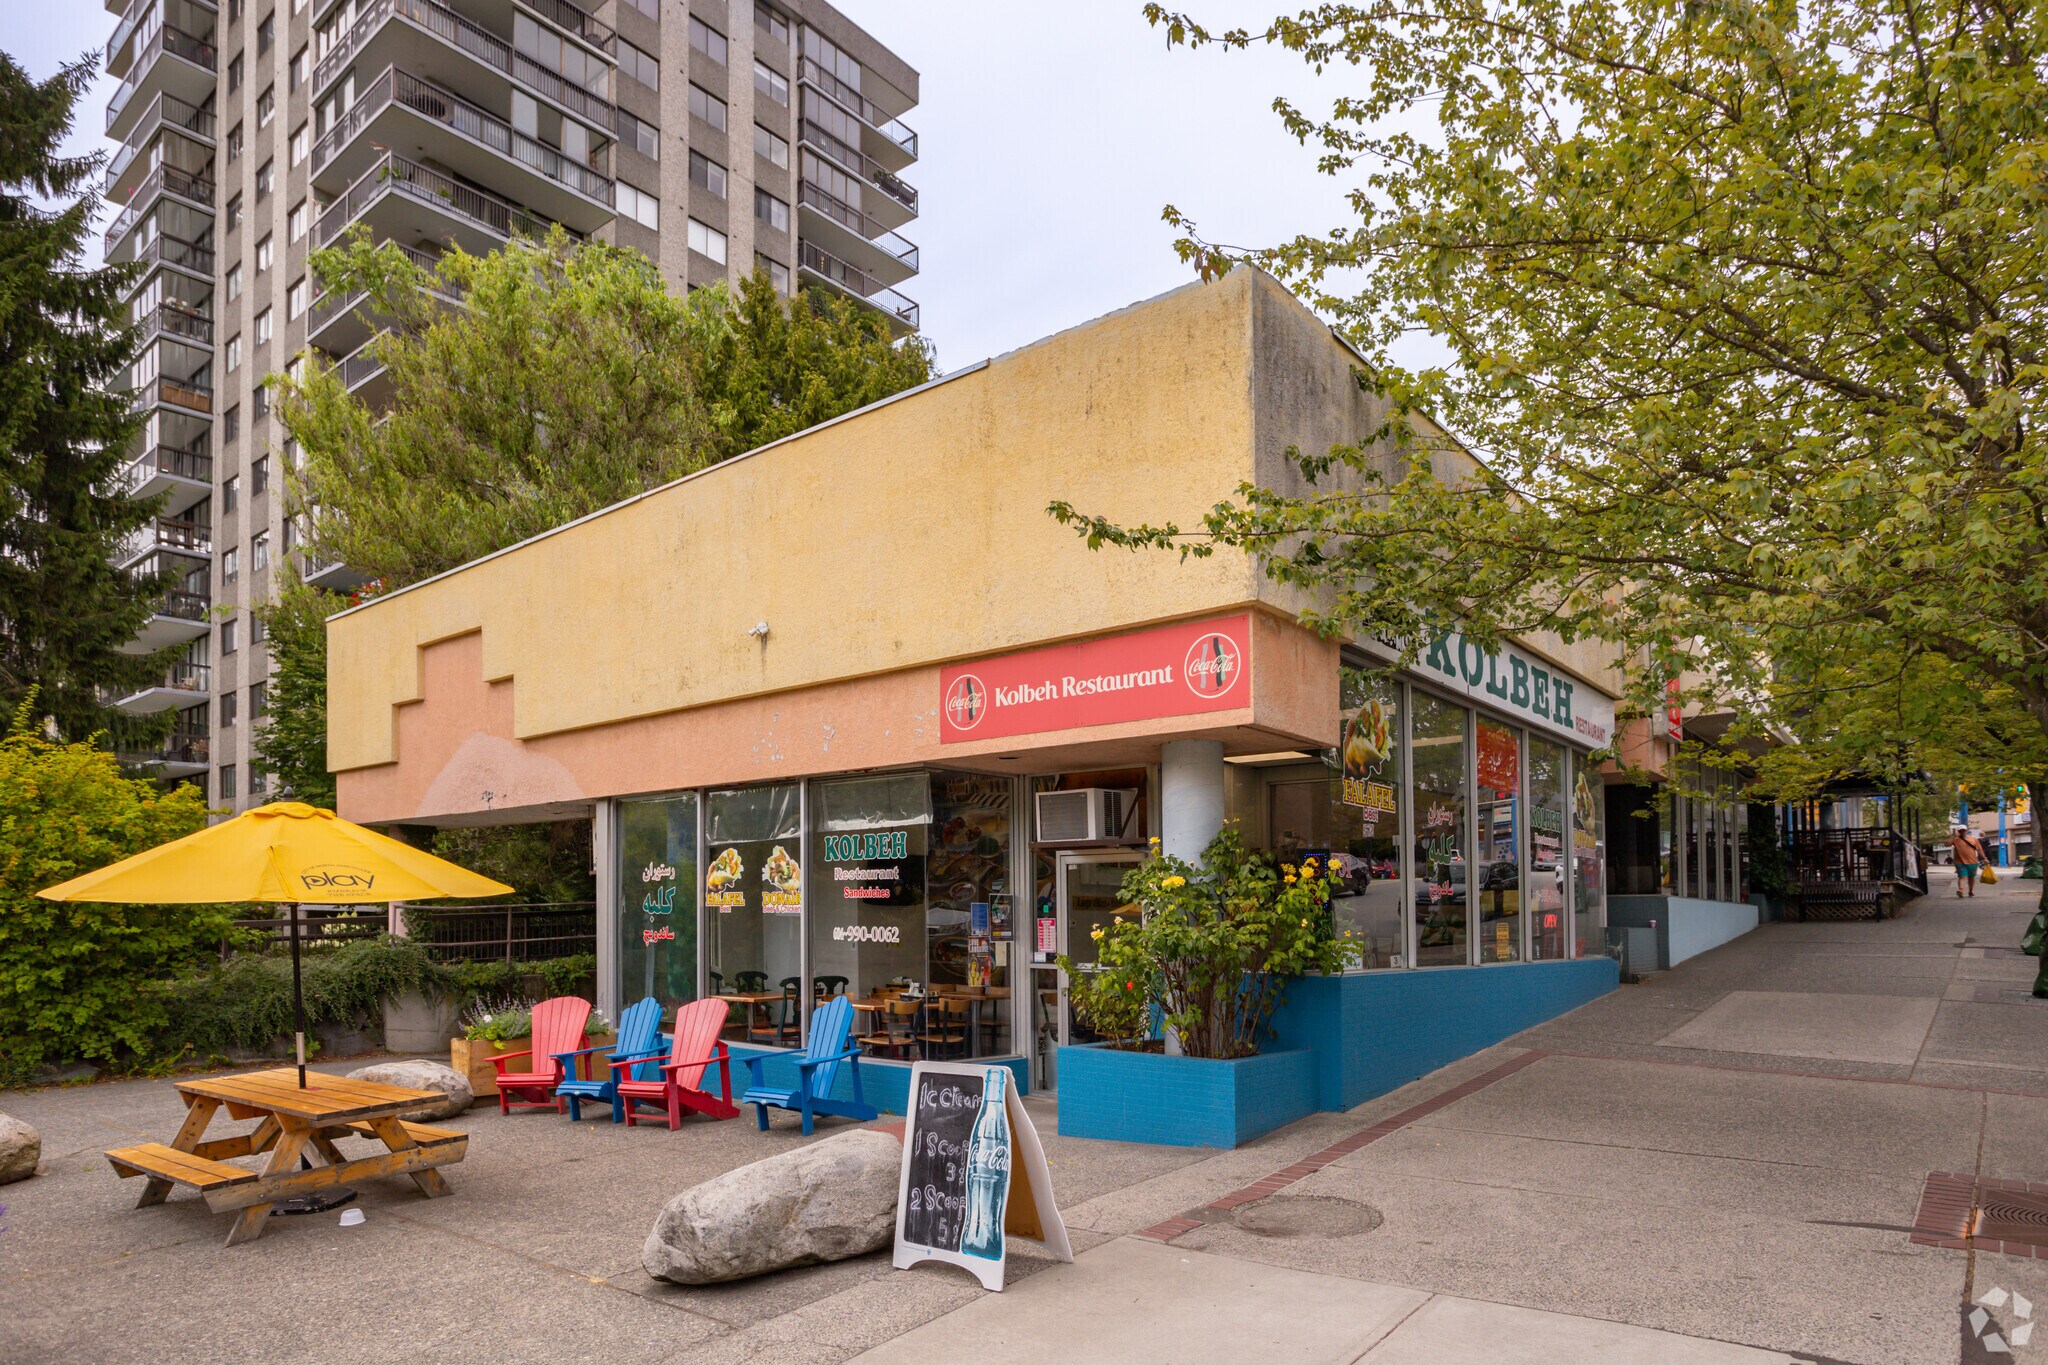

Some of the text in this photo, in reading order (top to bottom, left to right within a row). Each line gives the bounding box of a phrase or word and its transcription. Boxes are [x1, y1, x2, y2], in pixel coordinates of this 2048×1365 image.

[1425, 607, 1574, 730] KOLBEH
[995, 664, 1175, 707] Kolbeh Restaurant
[1575, 715, 1606, 744] RESTAURANT
[1343, 777, 1396, 813] FALAFEL
[824, 831, 907, 862] KOLBEH
[300, 871, 375, 890] play
[833, 866, 900, 881] Restaurant
[706, 892, 745, 906] FALAFEL
[844, 886, 891, 899] Sandwiches
[911, 1187, 922, 1211] 2
